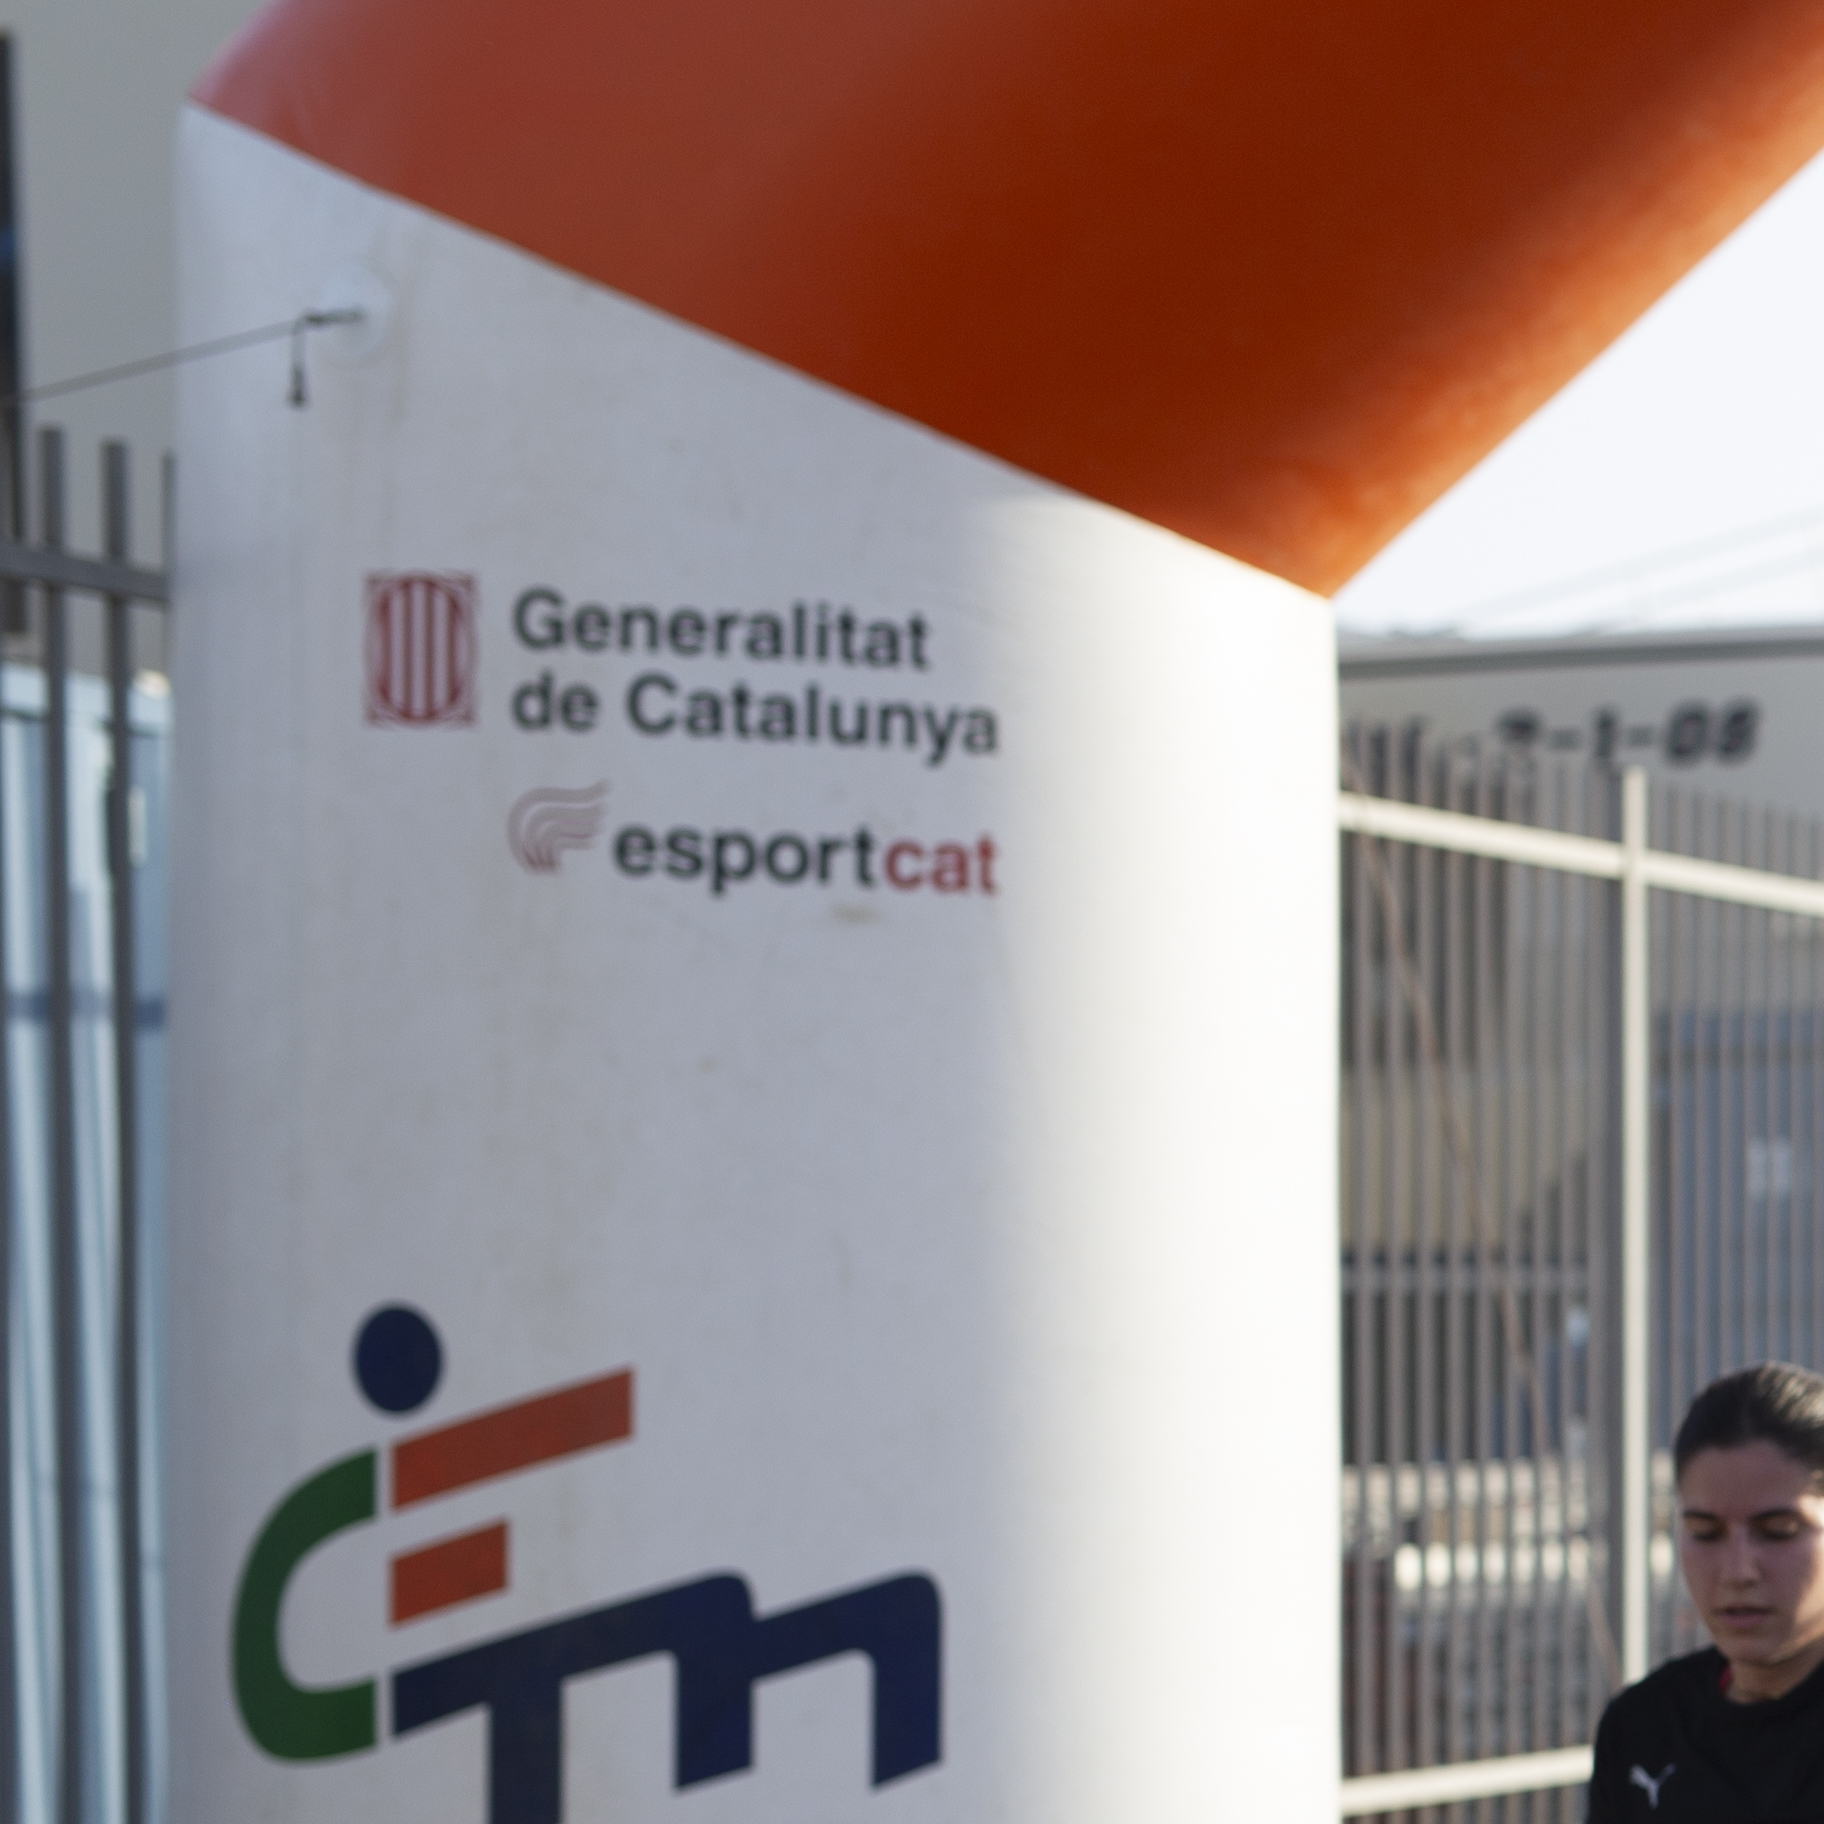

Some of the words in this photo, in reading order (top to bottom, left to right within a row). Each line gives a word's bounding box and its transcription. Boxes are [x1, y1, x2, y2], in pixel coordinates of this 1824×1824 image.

[513, 586, 930, 672] Generalitat
[511, 670, 598, 734] de
[626, 670, 999, 769] Catalunya
[612, 823, 997, 897] esportcat
